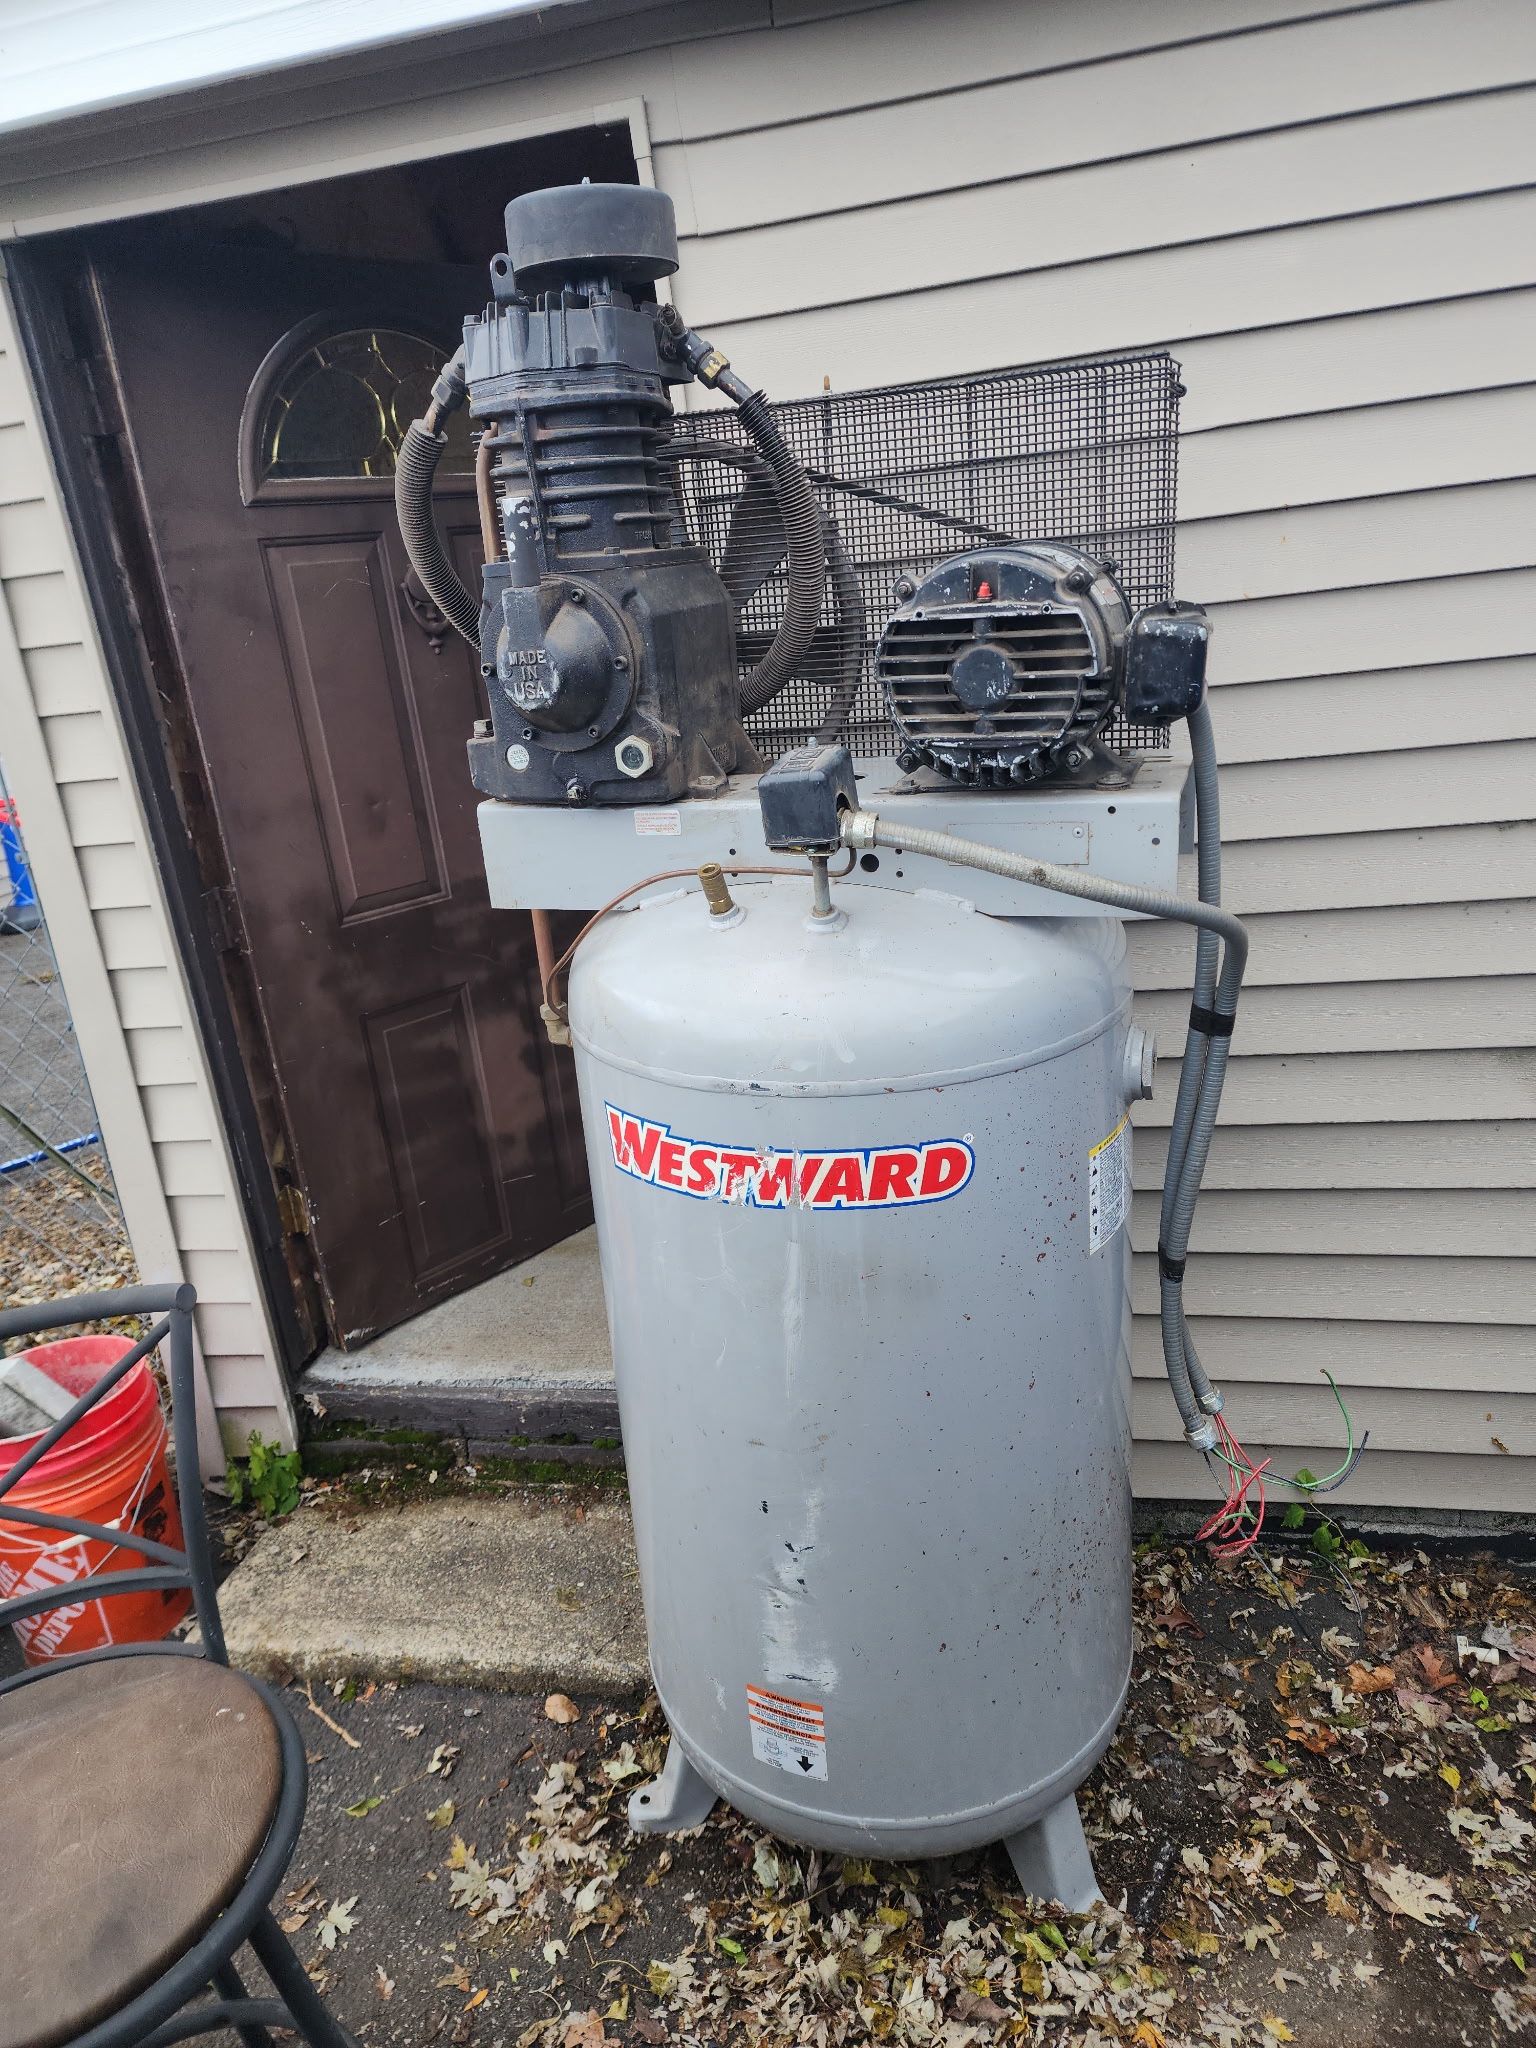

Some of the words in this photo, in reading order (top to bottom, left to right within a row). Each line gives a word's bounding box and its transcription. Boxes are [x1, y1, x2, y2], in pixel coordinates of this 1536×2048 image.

[508, 650, 547, 666] MADE
[521, 666, 538, 680] IN
[514, 680, 546, 700] USA
[606, 1104, 973, 1207] WESTWARD
[33, 1602, 86, 1656] DEPO
